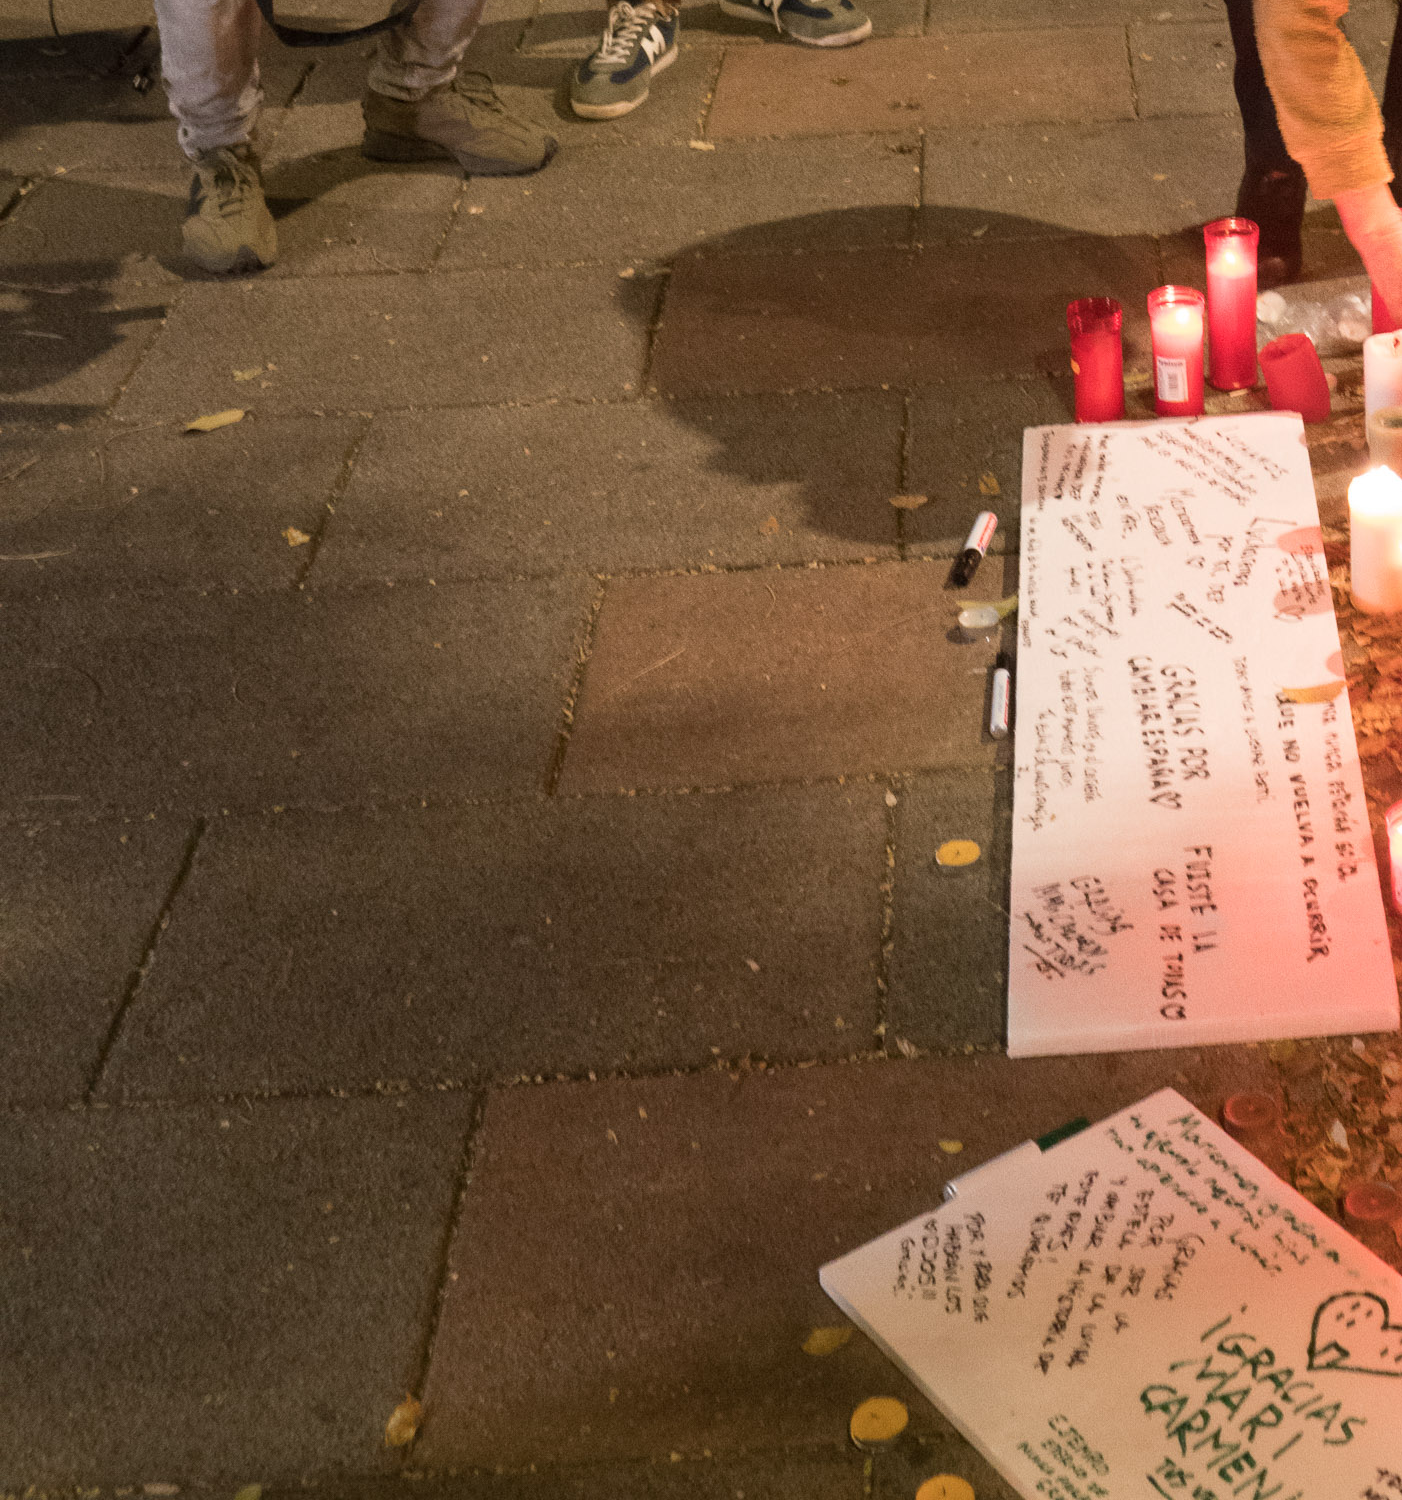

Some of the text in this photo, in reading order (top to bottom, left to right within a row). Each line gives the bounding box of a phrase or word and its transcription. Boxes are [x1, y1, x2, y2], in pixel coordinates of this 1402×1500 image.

[1126, 655, 1162, 727] CAMBIAR
[1159, 665, 1205, 742] GRACIAS
[1140, 728, 1175, 791] ESPAÑA
[1179, 747, 1211, 781] POR
[1274, 689, 1333, 964] QUE NO VUELVA A OCURRIR
[1151, 867, 1180, 912] CASA
[1183, 844, 1219, 955] FUISTE LA
[1158, 923, 1184, 943] DE
[964, 1211, 986, 1243] POR
[1140, 1213, 1173, 1248] POR
[1121, 1265, 1146, 1298] SER
[1155, 1235, 1205, 1300] GRACIAS
[1169, 1355, 1304, 1460] MARI
[1139, 1384, 1303, 1500] CARMEN
